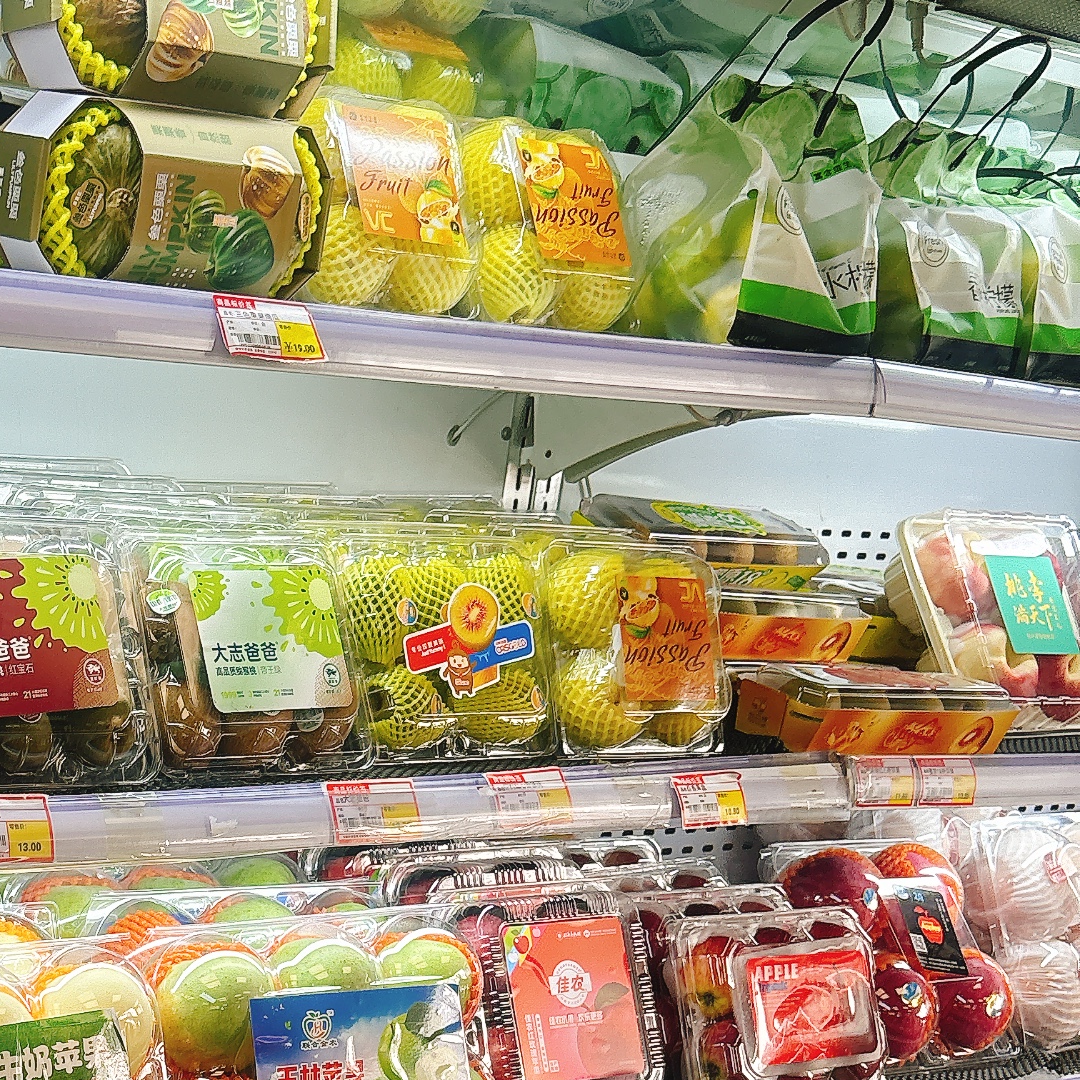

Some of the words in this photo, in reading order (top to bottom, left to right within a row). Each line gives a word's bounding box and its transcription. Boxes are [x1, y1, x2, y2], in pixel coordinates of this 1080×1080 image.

[360, 170, 411, 195] Fruit
[570, 182, 614, 208] Fruit
[365, 210, 397, 234] VC
[536, 205, 620, 238] Passion
[663, 619, 708, 642] Fruit
[211, 641, 278, 663] 大志爸爸
[623, 642, 711, 671] Passion
[9, 662, 34, 675] 红宝石
[18, 842, 42, 852] 13.00
[556, 974, 586, 994] 佳农
[754, 963, 800, 983] APPLE
